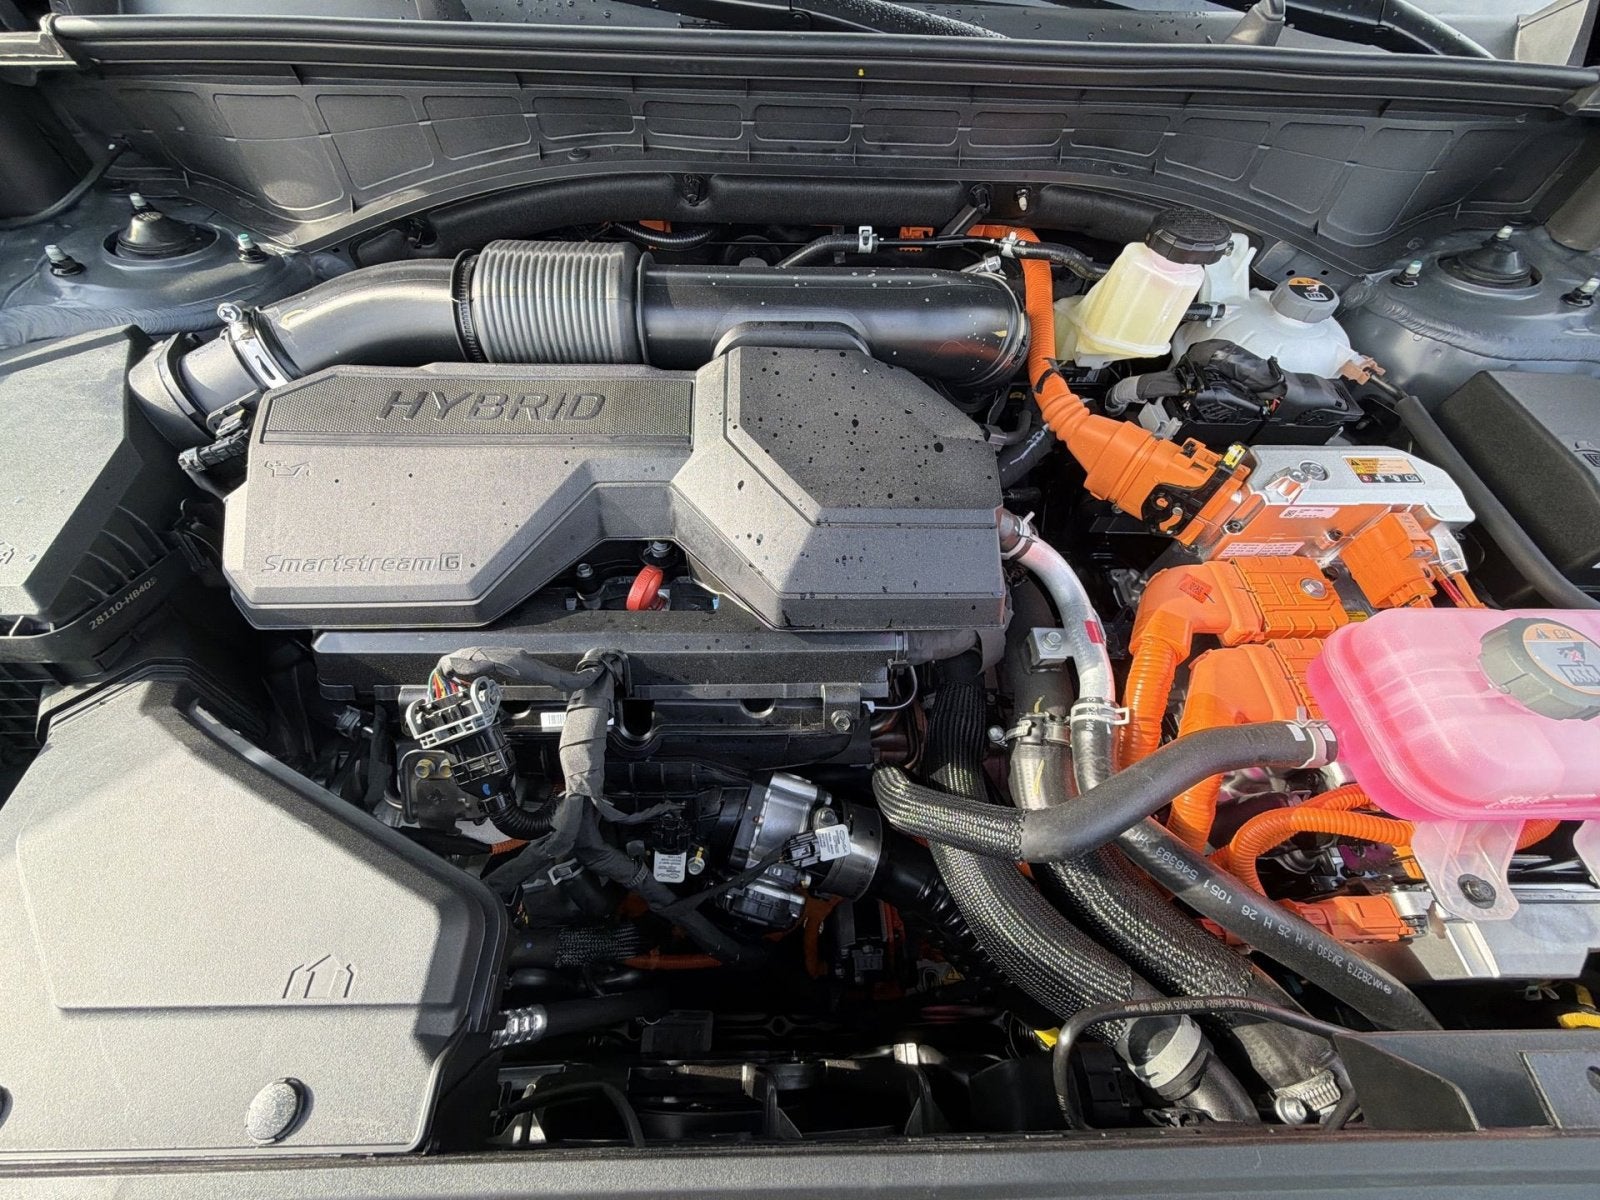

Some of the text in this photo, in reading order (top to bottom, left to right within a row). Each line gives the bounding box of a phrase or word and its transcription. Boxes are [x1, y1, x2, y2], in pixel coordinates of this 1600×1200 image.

[376, 390, 606, 422] HYBRID
[261, 554, 437, 573] Smartstream
[1241, 905, 1258, 921] 26
[1263, 916, 1273, 930] H
[1277, 924, 1292, 938] 25
